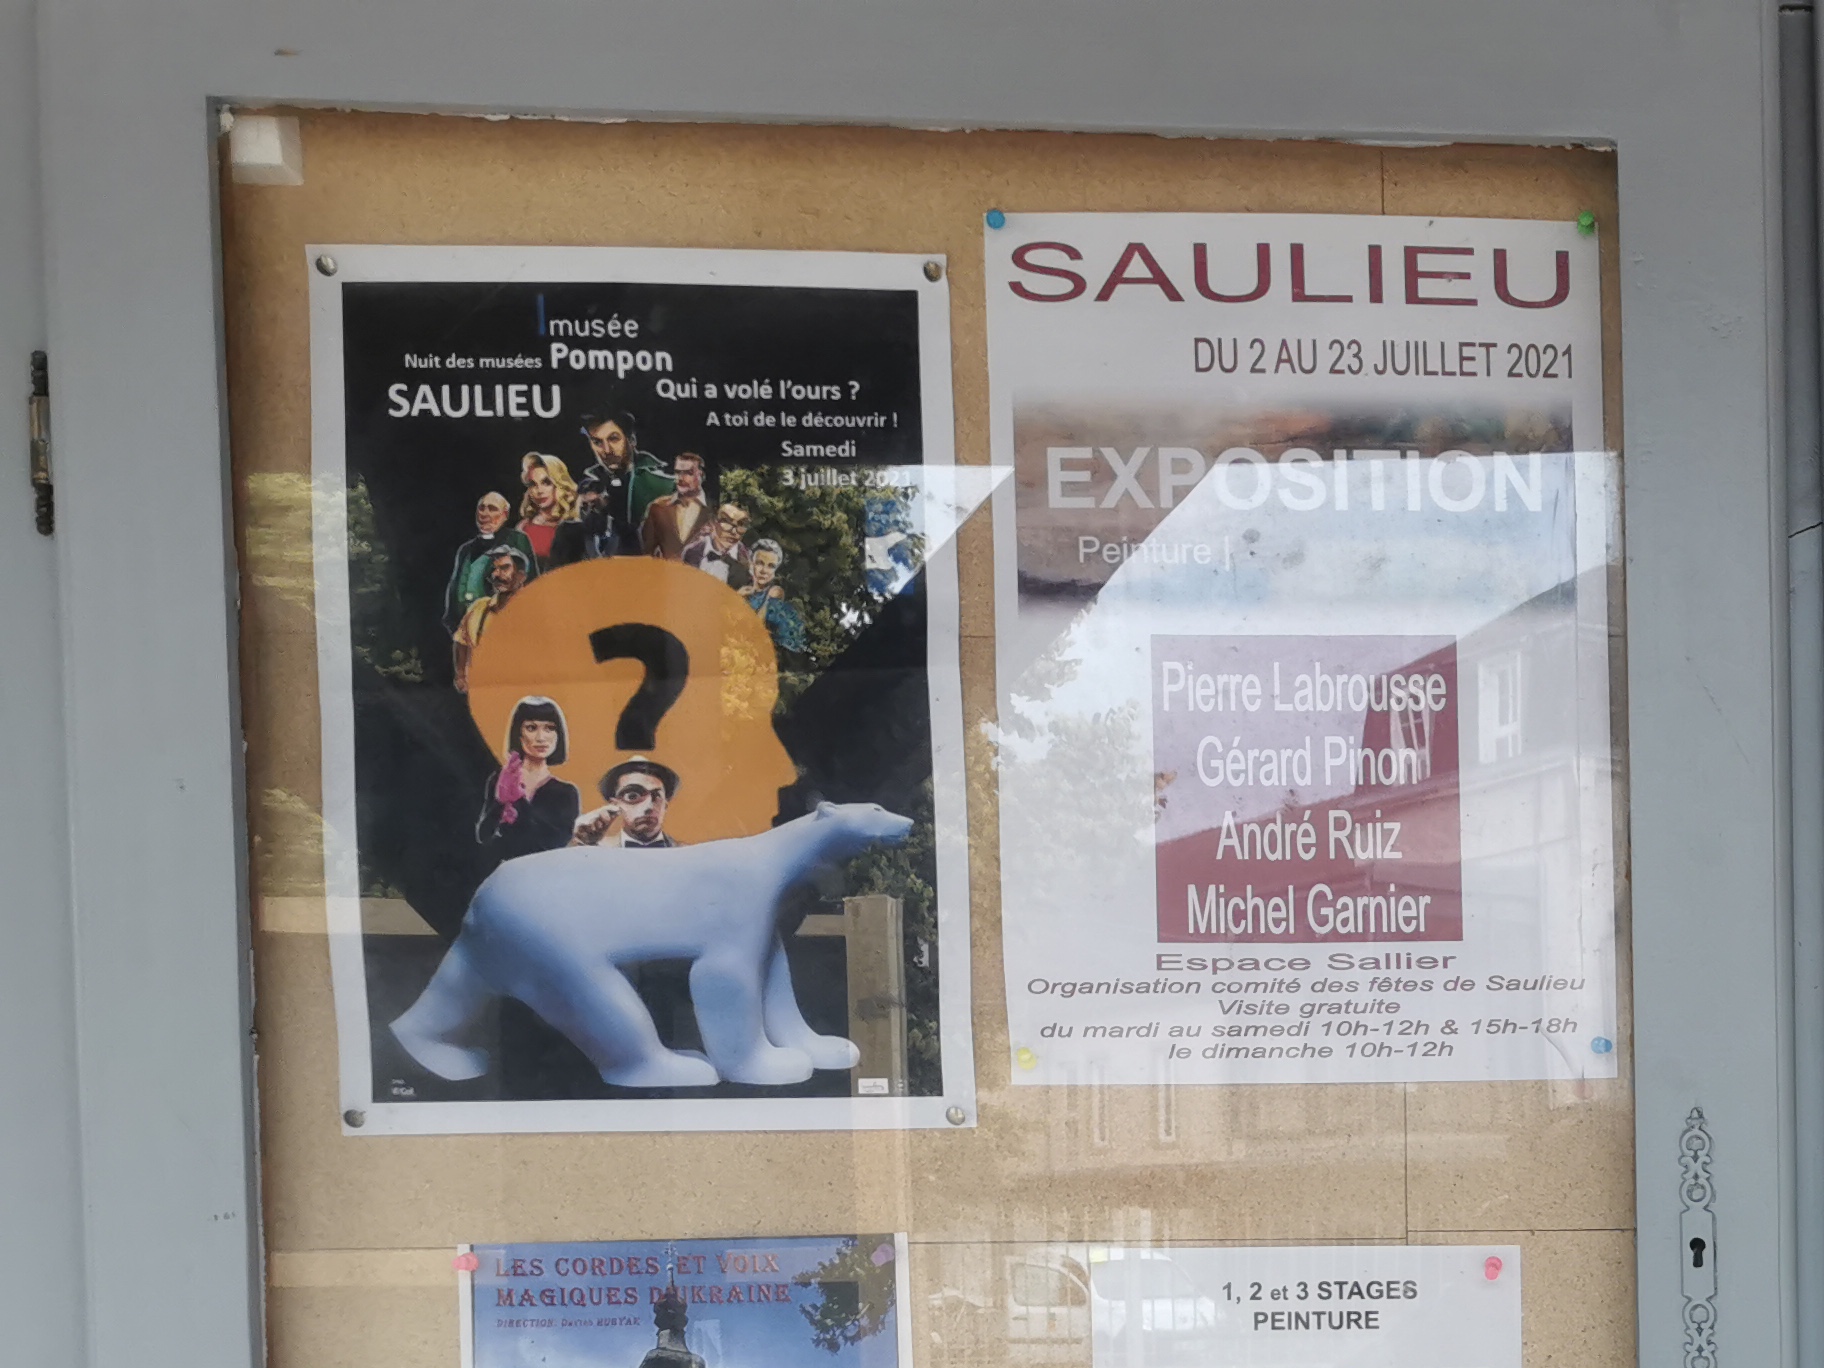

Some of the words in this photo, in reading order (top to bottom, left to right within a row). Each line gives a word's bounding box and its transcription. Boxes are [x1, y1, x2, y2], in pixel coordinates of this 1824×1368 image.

[1008, 241, 1570, 309] SAULIEU
[549, 314, 639, 339] musée
[404, 353, 441, 369] Nuit
[445, 353, 475, 369] des
[478, 353, 543, 370] musées
[549, 343, 674, 380] Pompon
[1195, 338, 1239, 374] DU
[1249, 339, 1267, 374] 2
[1274, 339, 1317, 375] AU
[1329, 340, 1364, 376] 23
[1373, 341, 1498, 377] JUILLET
[1507, 343, 1574, 378] 2021
[387, 383, 562, 419] SAULIEU
[656, 379, 698, 401] Qui
[704, 384, 719, 399] a
[723, 378, 773, 400] volé
[779, 380, 841, 400] l'ours
[706, 412, 720, 427] A
[724, 411, 747, 427] toi
[754, 411, 776, 428] de
[781, 411, 797, 428] le
[802, 411, 887, 428] découvrir
[781, 441, 857, 459] Samedi
[781, 469, 794, 486] 3
[797, 468, 857, 490] juillet
[1047, 446, 1543, 512] EXPOSITION
[1078, 536, 1212, 565] Peinture
[1163, 661, 1262, 712] Pierre
[1273, 661, 1448, 712] Labrousse
[1196, 735, 1312, 787] Gérard
[1324, 736, 1418, 786] Pinon
[1216, 810, 1316, 861] André
[1329, 809, 1403, 860] Ruiz
[1187, 883, 1295, 934] Michel
[1306, 883, 1431, 934] Garnier
[1155, 953, 1312, 975] Espace
[1327, 952, 1457, 971] Sallier
[1217, 999, 1290, 1016] Visite
[1299, 999, 1401, 1019] gratuite
[1168, 1043, 1192, 1059] le
[1201, 1042, 1336, 1060] dimanche
[1344, 1041, 1455, 1058] 10h-12h
[495, 1257, 544, 1277] LES
[554, 1256, 661, 1277] CORDES
[676, 1255, 708, 1276] ET
[717, 1253, 781, 1275] VOIX
[495, 1286, 639, 1308] MAGIQUES
[1222, 1282, 1241, 1304] 1,
[1249, 1282, 1263, 1300] 2
[1270, 1283, 1289, 1300] et
[1296, 1281, 1309, 1300] 3
[1317, 1280, 1418, 1300] STAGES
[1254, 1310, 1380, 1331] PEINTURE
